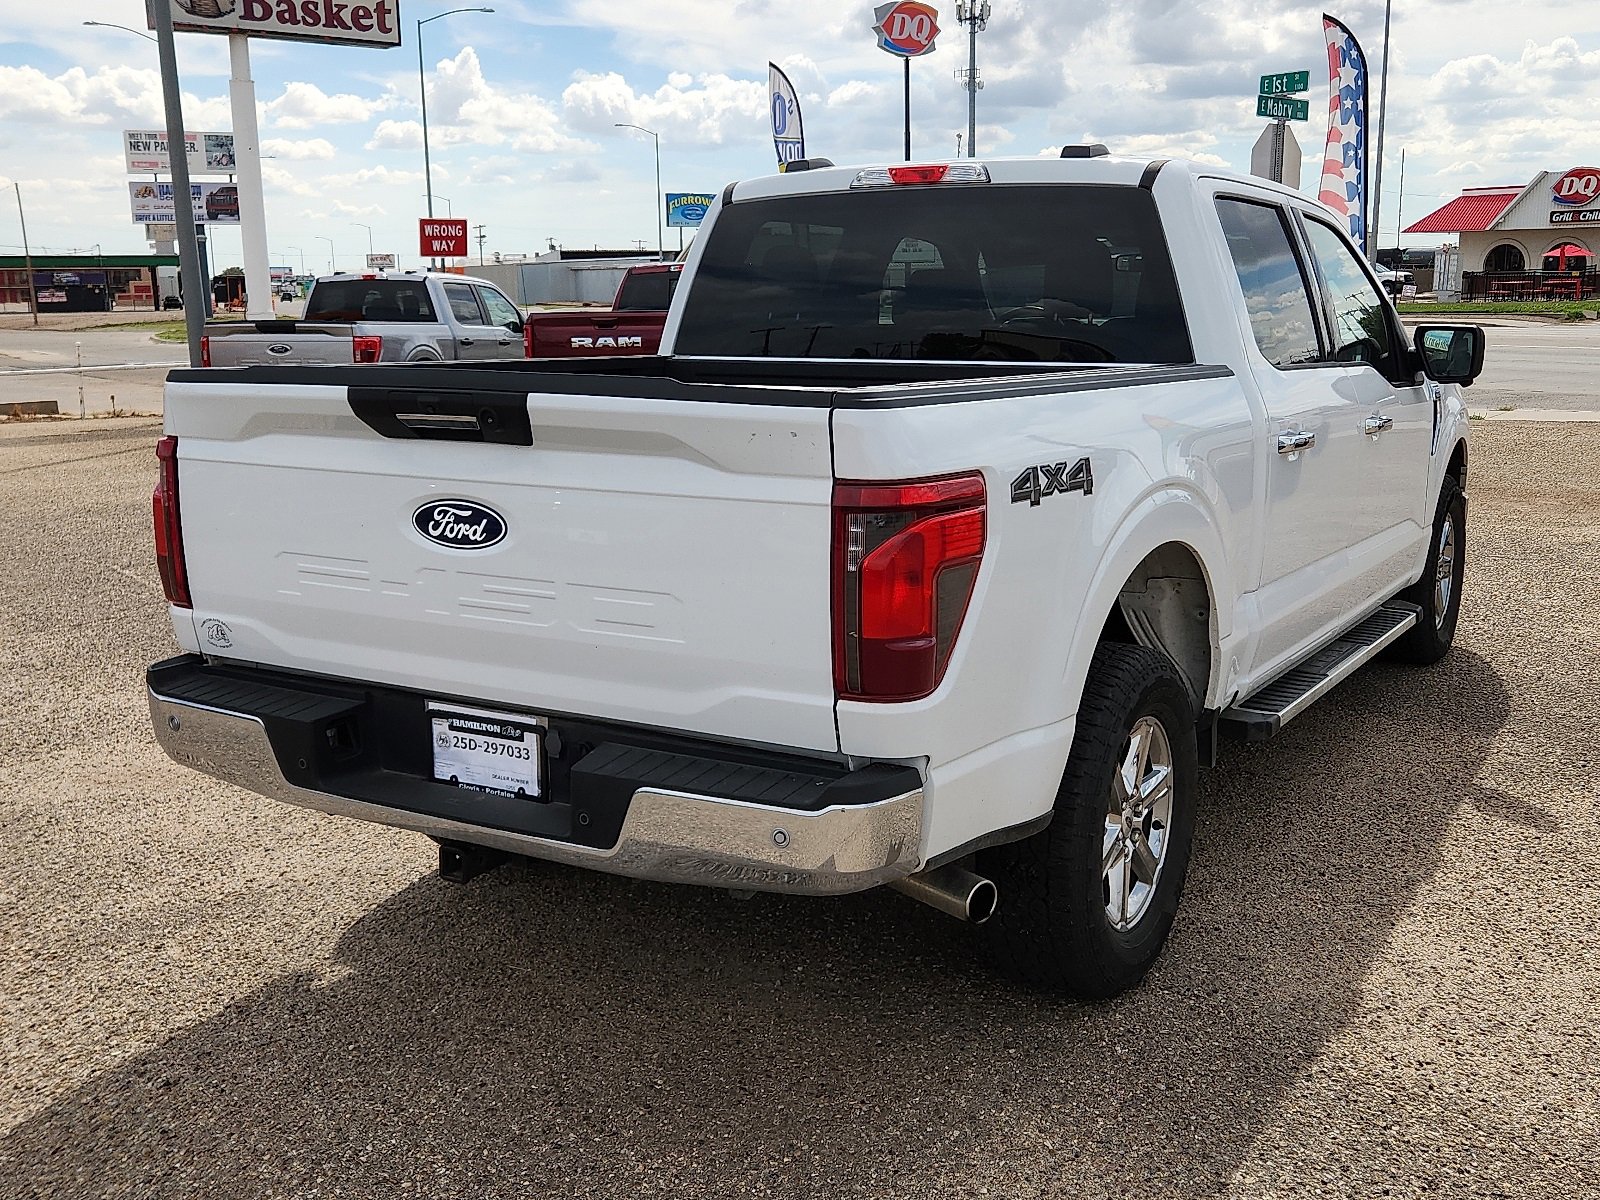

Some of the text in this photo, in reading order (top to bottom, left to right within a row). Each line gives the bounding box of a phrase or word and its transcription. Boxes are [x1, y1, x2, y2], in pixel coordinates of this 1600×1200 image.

[239, 0, 393, 34] Basket
[891, 13, 931, 45] DQ
[1264, 75, 1288, 93] E 1st
[1261, 98, 1294, 119] E Mabry
[129, 141, 152, 152] NEW
[1560, 175, 1598, 197] DQ
[1552, 213, 1574, 222] Grill
[424, 224, 463, 237] WRONG
[432, 240, 456, 252] WAY
[571, 337, 642, 348] RAM
[428, 506, 488, 542] Ford
[452, 719, 501, 734] HAMILTON
[452, 735, 531, 761] 25D-297033
